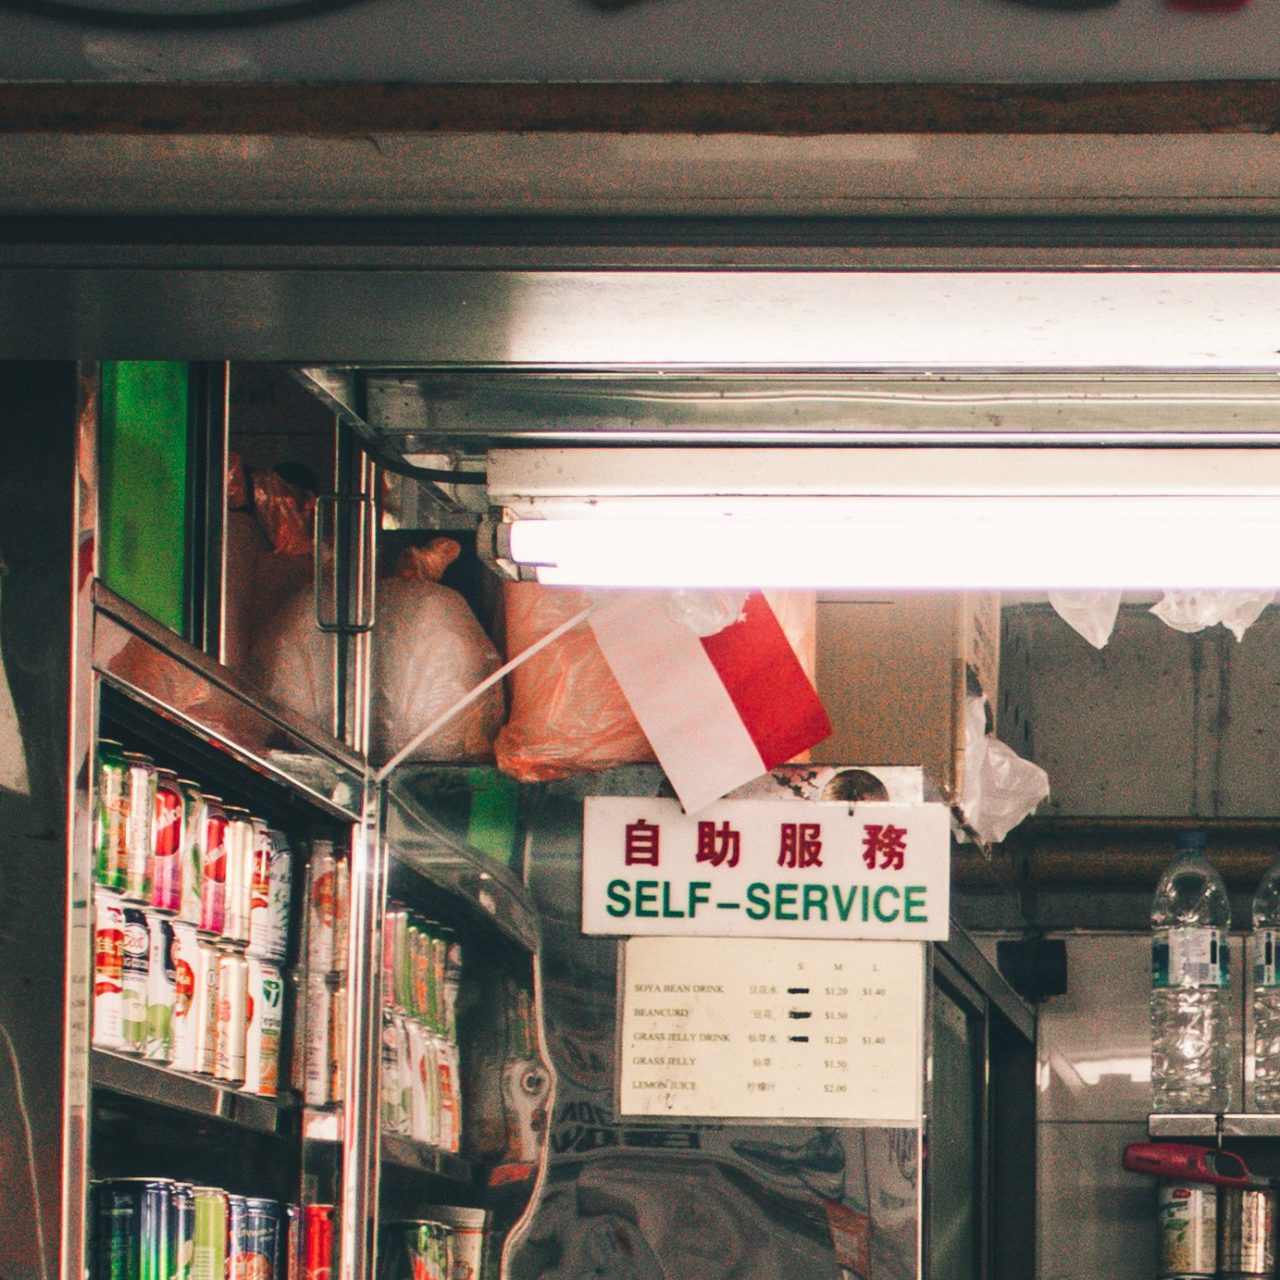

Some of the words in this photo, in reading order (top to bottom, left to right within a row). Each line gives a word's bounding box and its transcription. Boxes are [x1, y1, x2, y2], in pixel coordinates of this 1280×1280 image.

[625, 820, 907, 870] 自助服務
[606, 879, 928, 923] SELF-SERVICE
[797, 963, 804, 971] S
[834, 963, 843, 971] M
[872, 964, 879, 972] L
[634, 984, 661, 993] SOYA
[664, 985, 690, 993] BEAN
[693, 985, 724, 993] DRINK
[825, 987, 848, 996] $1.20
[862, 988, 886, 996] $1.40
[633, 1009, 689, 1017] BEANCURD
[825, 1012, 848, 1020] $1.50
[633, 1033, 665, 1041] GRASS
[668, 1033, 696, 1041] JELLY
[699, 1033, 730, 1041] DRINK
[825, 1036, 848, 1044] $1.20
[862, 1036, 886, 1045] $1.40
[632, 1057, 665, 1065] GRASS
[667, 1057, 696, 1065] JELLY
[824, 1060, 847, 1069] $1.50
[632, 1081, 667, 1089] LEMON
[670, 1081, 697, 1090] JUICE
[824, 1084, 847, 1093] $2.00
